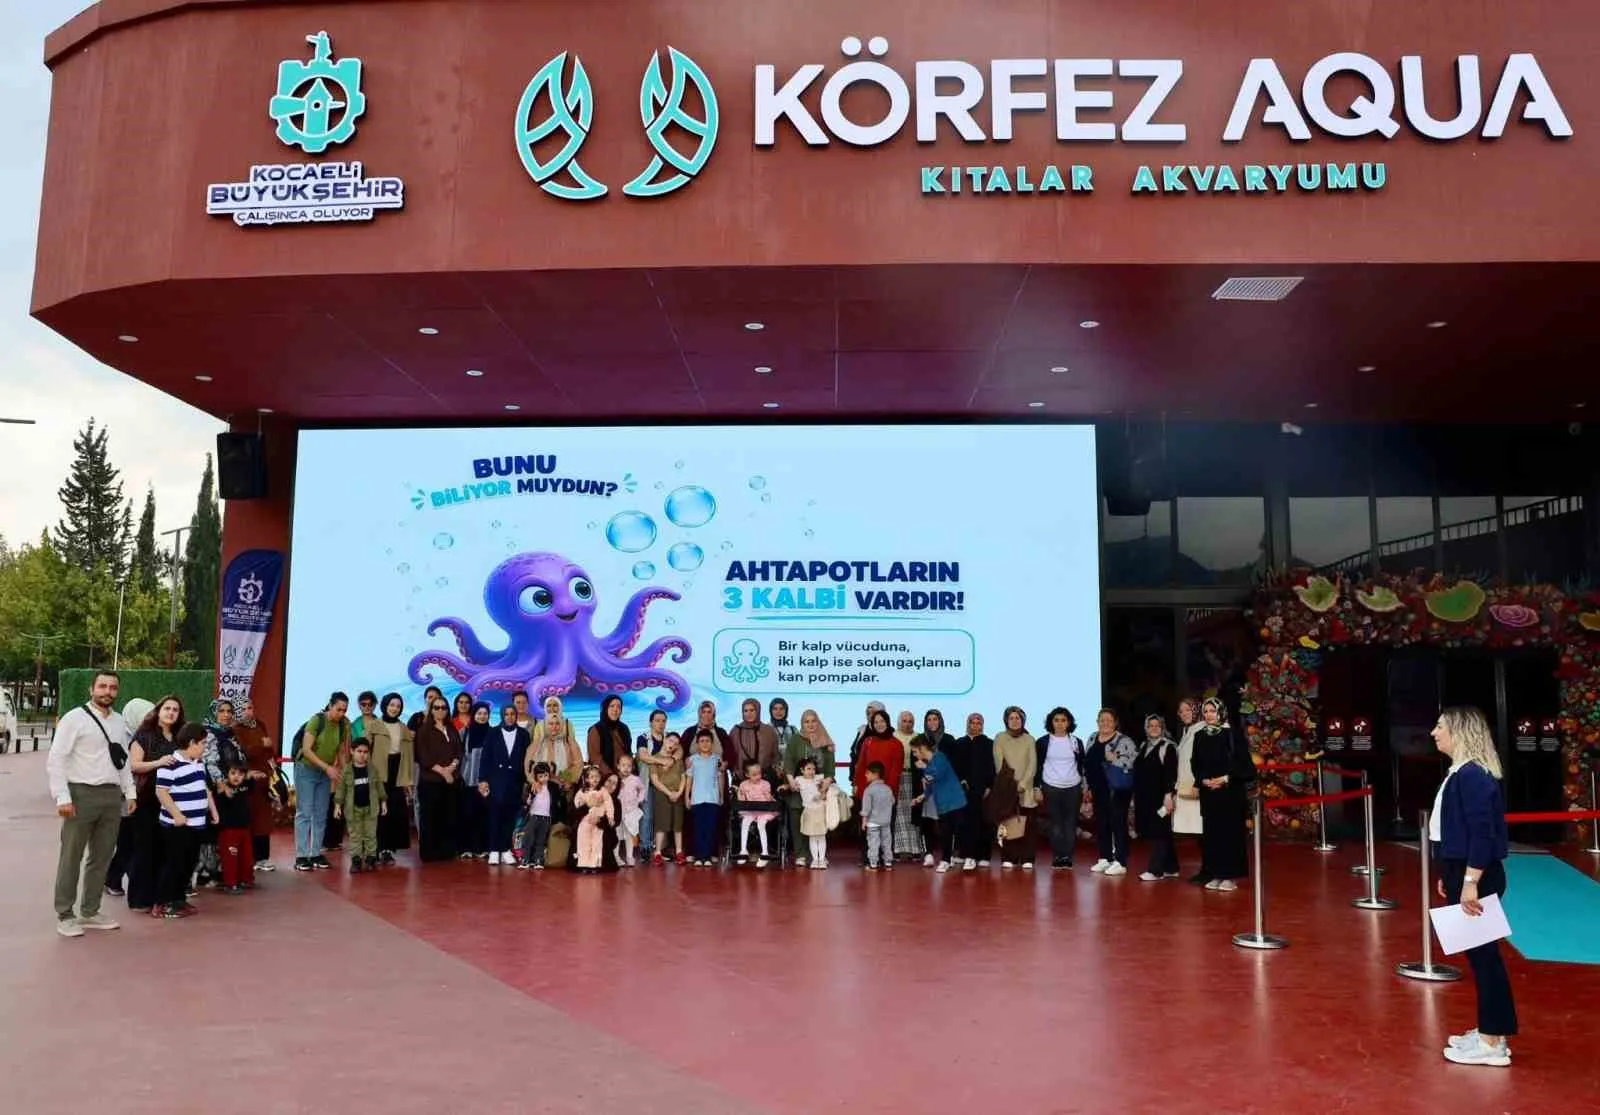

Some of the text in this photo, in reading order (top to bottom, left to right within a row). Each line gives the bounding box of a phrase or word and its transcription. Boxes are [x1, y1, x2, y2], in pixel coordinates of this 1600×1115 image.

[755, 36, 1574, 145] KÖRFEZ AQUA
[253, 163, 359, 182] KOCAELİ
[921, 162, 1387, 192] KITALAR AKVARYUMU
[210, 179, 401, 204] BÜYÜKŞEHİR
[236, 208, 371, 223] ÇALIŞINCA OLUYOR
[473, 454, 557, 479] BUNU
[430, 478, 618, 508] BİLİYOR MUYDUN?
[725, 560, 960, 582] AHTAPOTLARIN
[723, 584, 965, 611] 3 KALBİ VARDIR!
[778, 640, 910, 655] Bir kalp vücuduna,
[778, 656, 961, 670] iki kalp ise solungaçlarına
[778, 672, 880, 686] kan pompalar.
